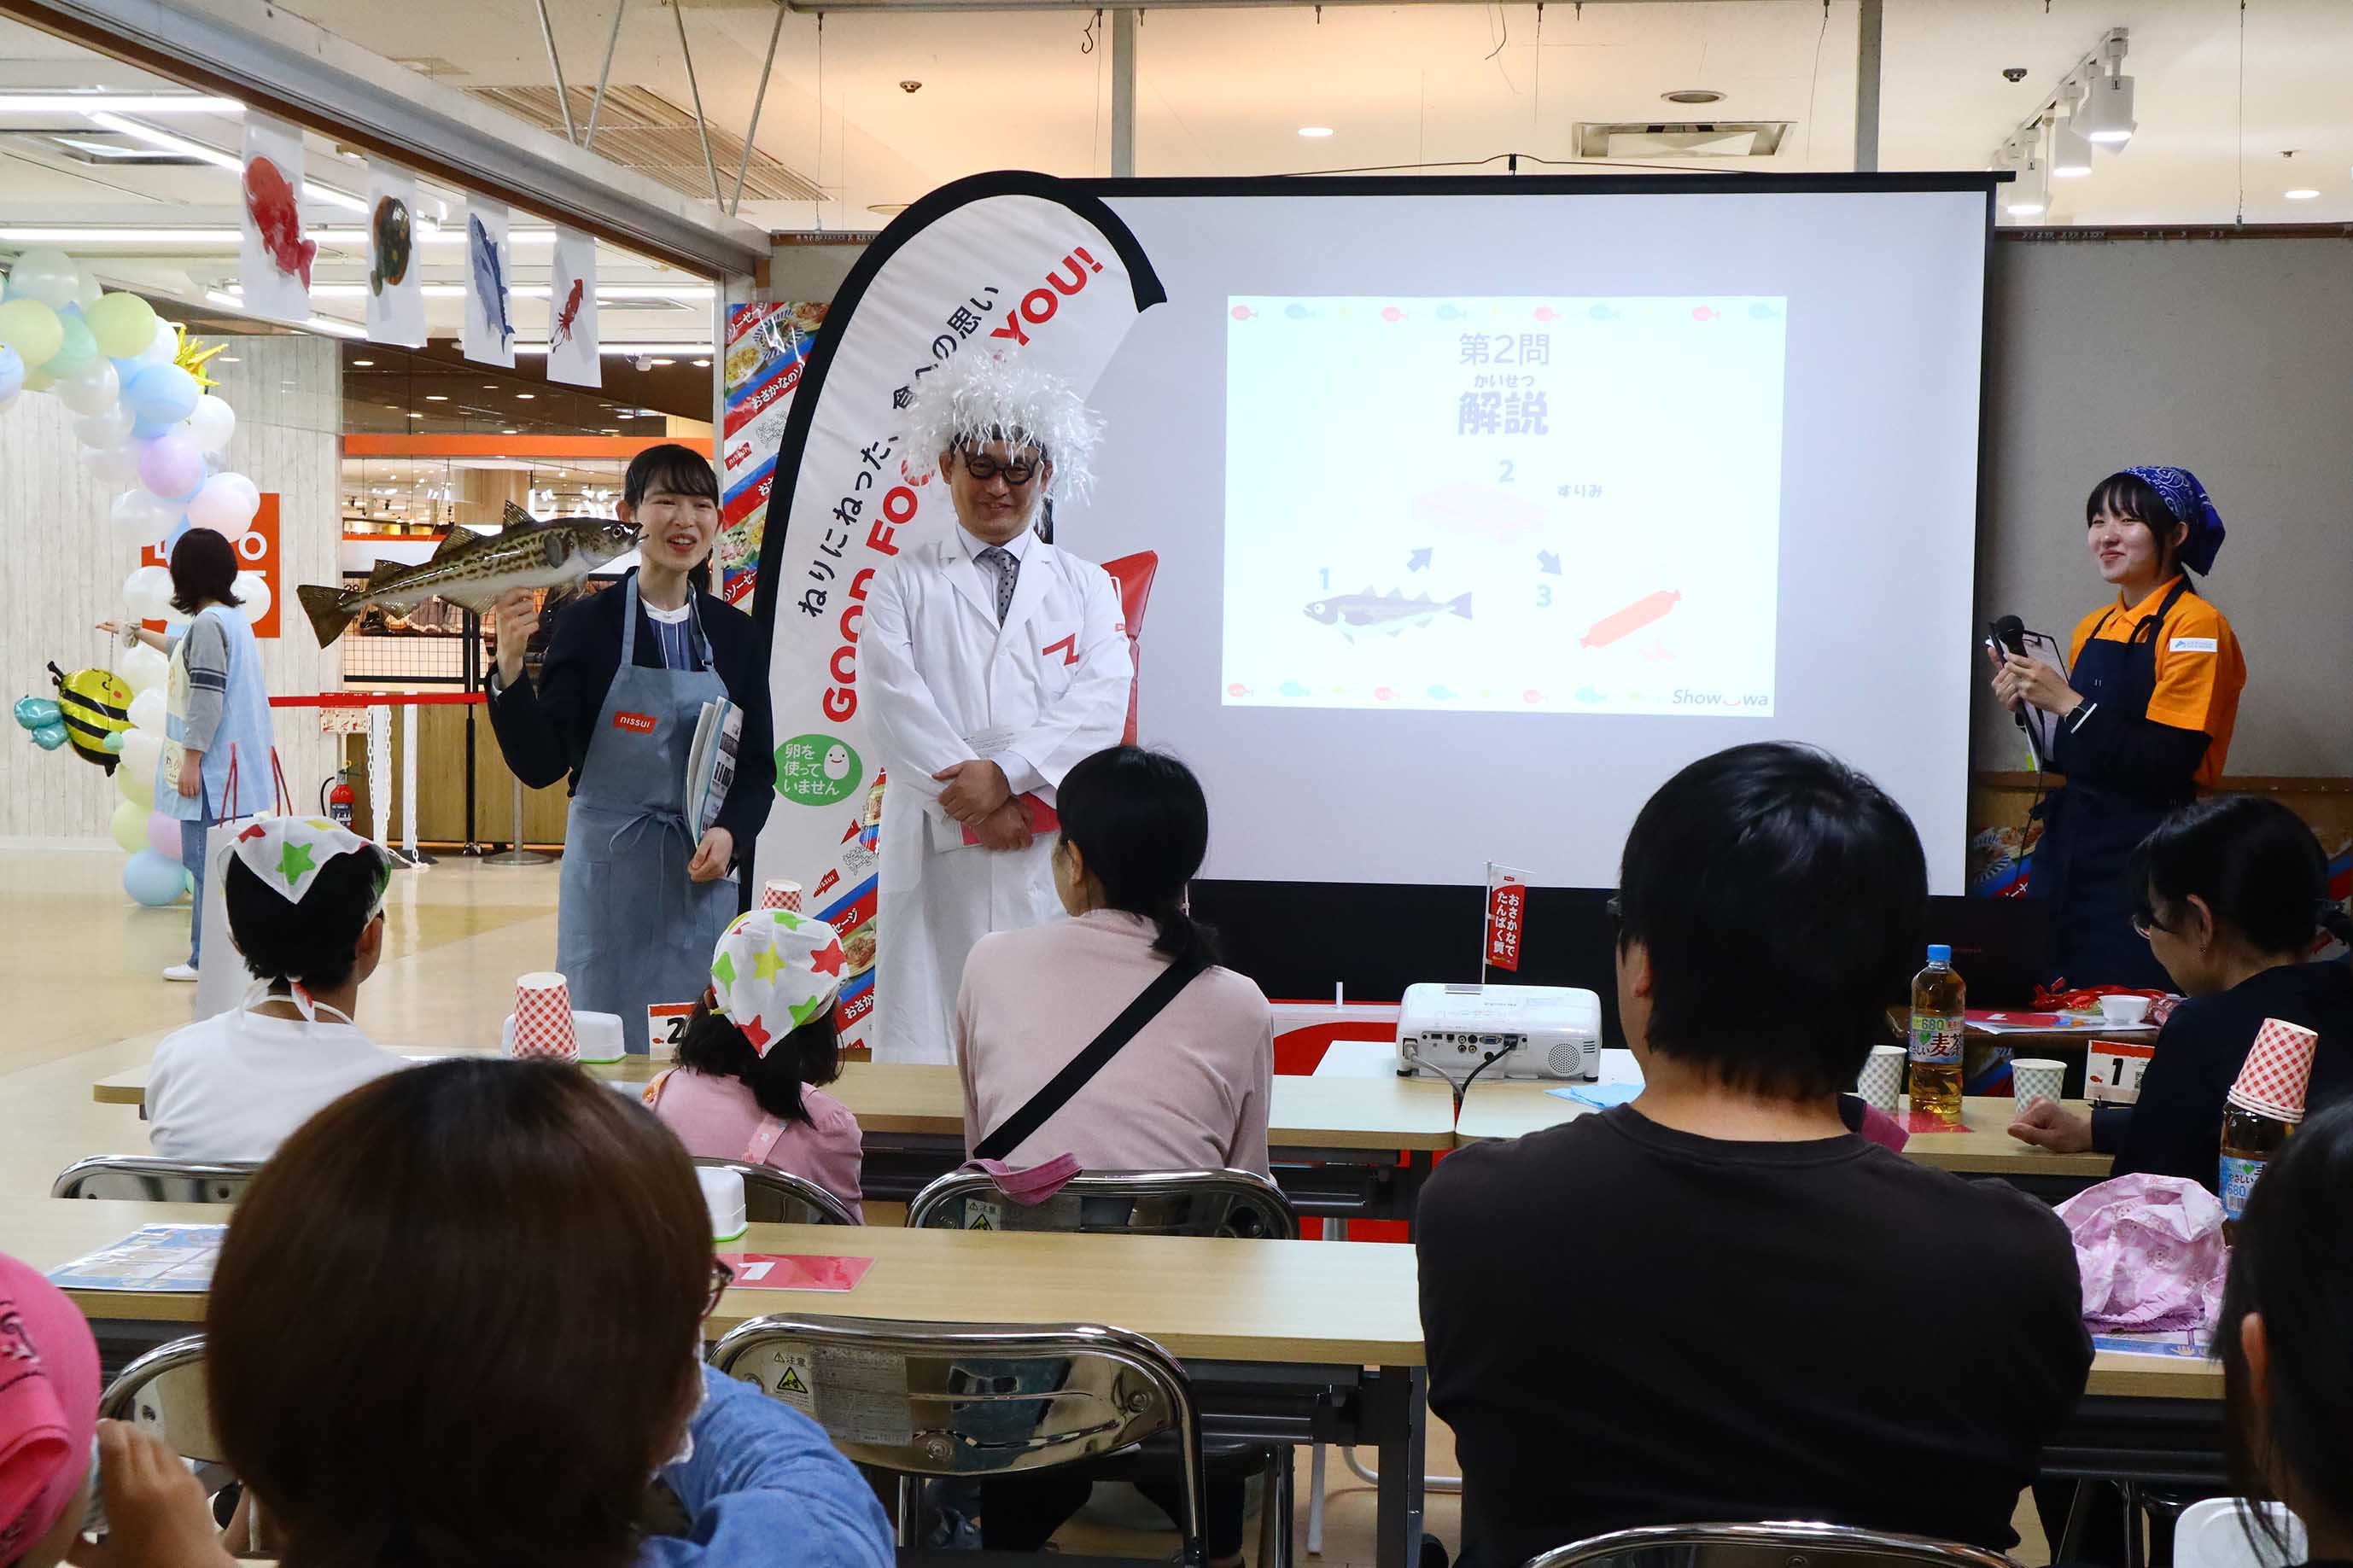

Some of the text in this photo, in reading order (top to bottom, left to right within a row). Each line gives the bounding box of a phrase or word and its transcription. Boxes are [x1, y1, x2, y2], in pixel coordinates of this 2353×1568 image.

[990, 246, 1104, 347] YOU!
[1459, 333, 1550, 366] 第2問
[1458, 391, 1549, 435] 解説
[620, 715, 651, 729] nissui
[785, 743, 816, 761] 卵を
[784, 761, 822, 778] 使って
[783, 779, 840, 796] いません
[667, 1017, 686, 1044] 2
[2111, 1058, 2124, 1087] 1
[2227, 1183, 2246, 1197] 680
